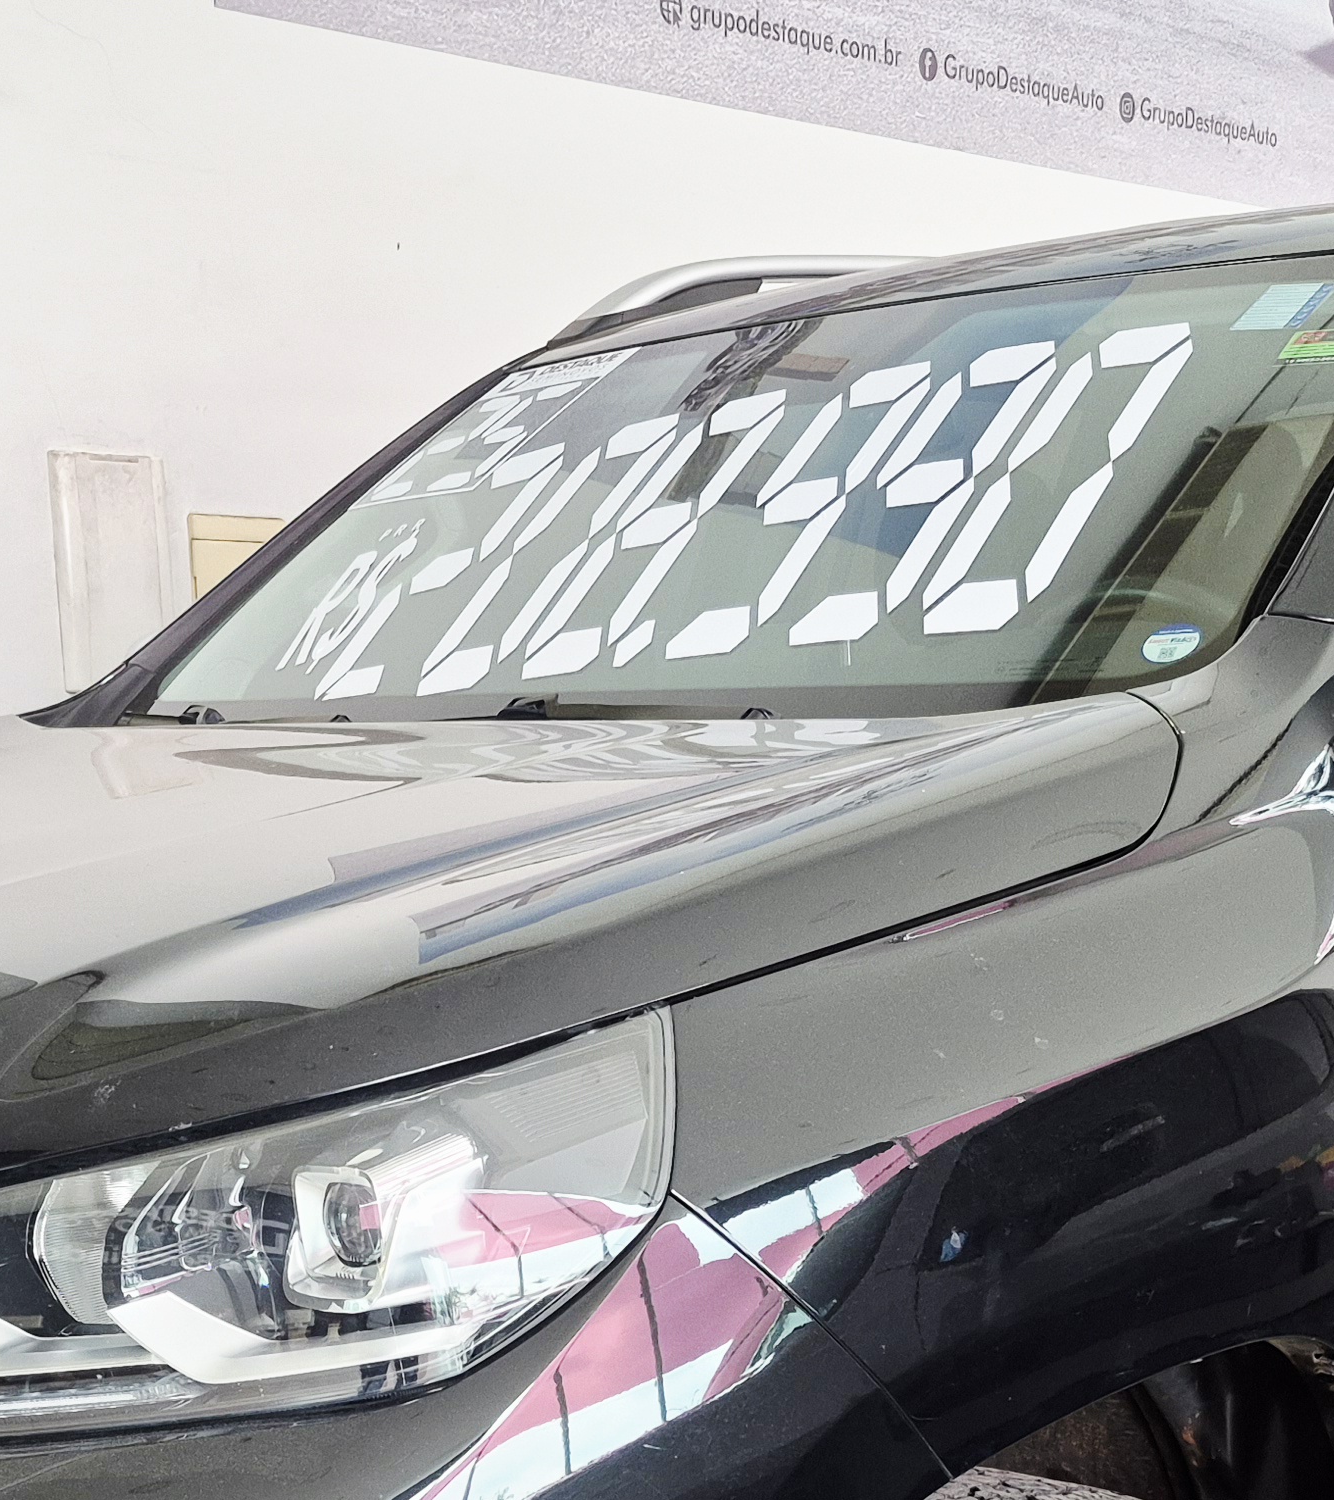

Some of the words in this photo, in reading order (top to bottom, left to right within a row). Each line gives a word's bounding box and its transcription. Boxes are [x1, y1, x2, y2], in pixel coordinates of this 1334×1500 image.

[689, 5, 902, 67] grupodestaque.com.br
[943, 54, 1105, 112] GrupoDestaqueAuto
[1139, 97, 1278, 148] GrupoDestaqueAuto
[539, 352, 623, 376] DESTAQUE
[275, 533, 418, 675] R$
